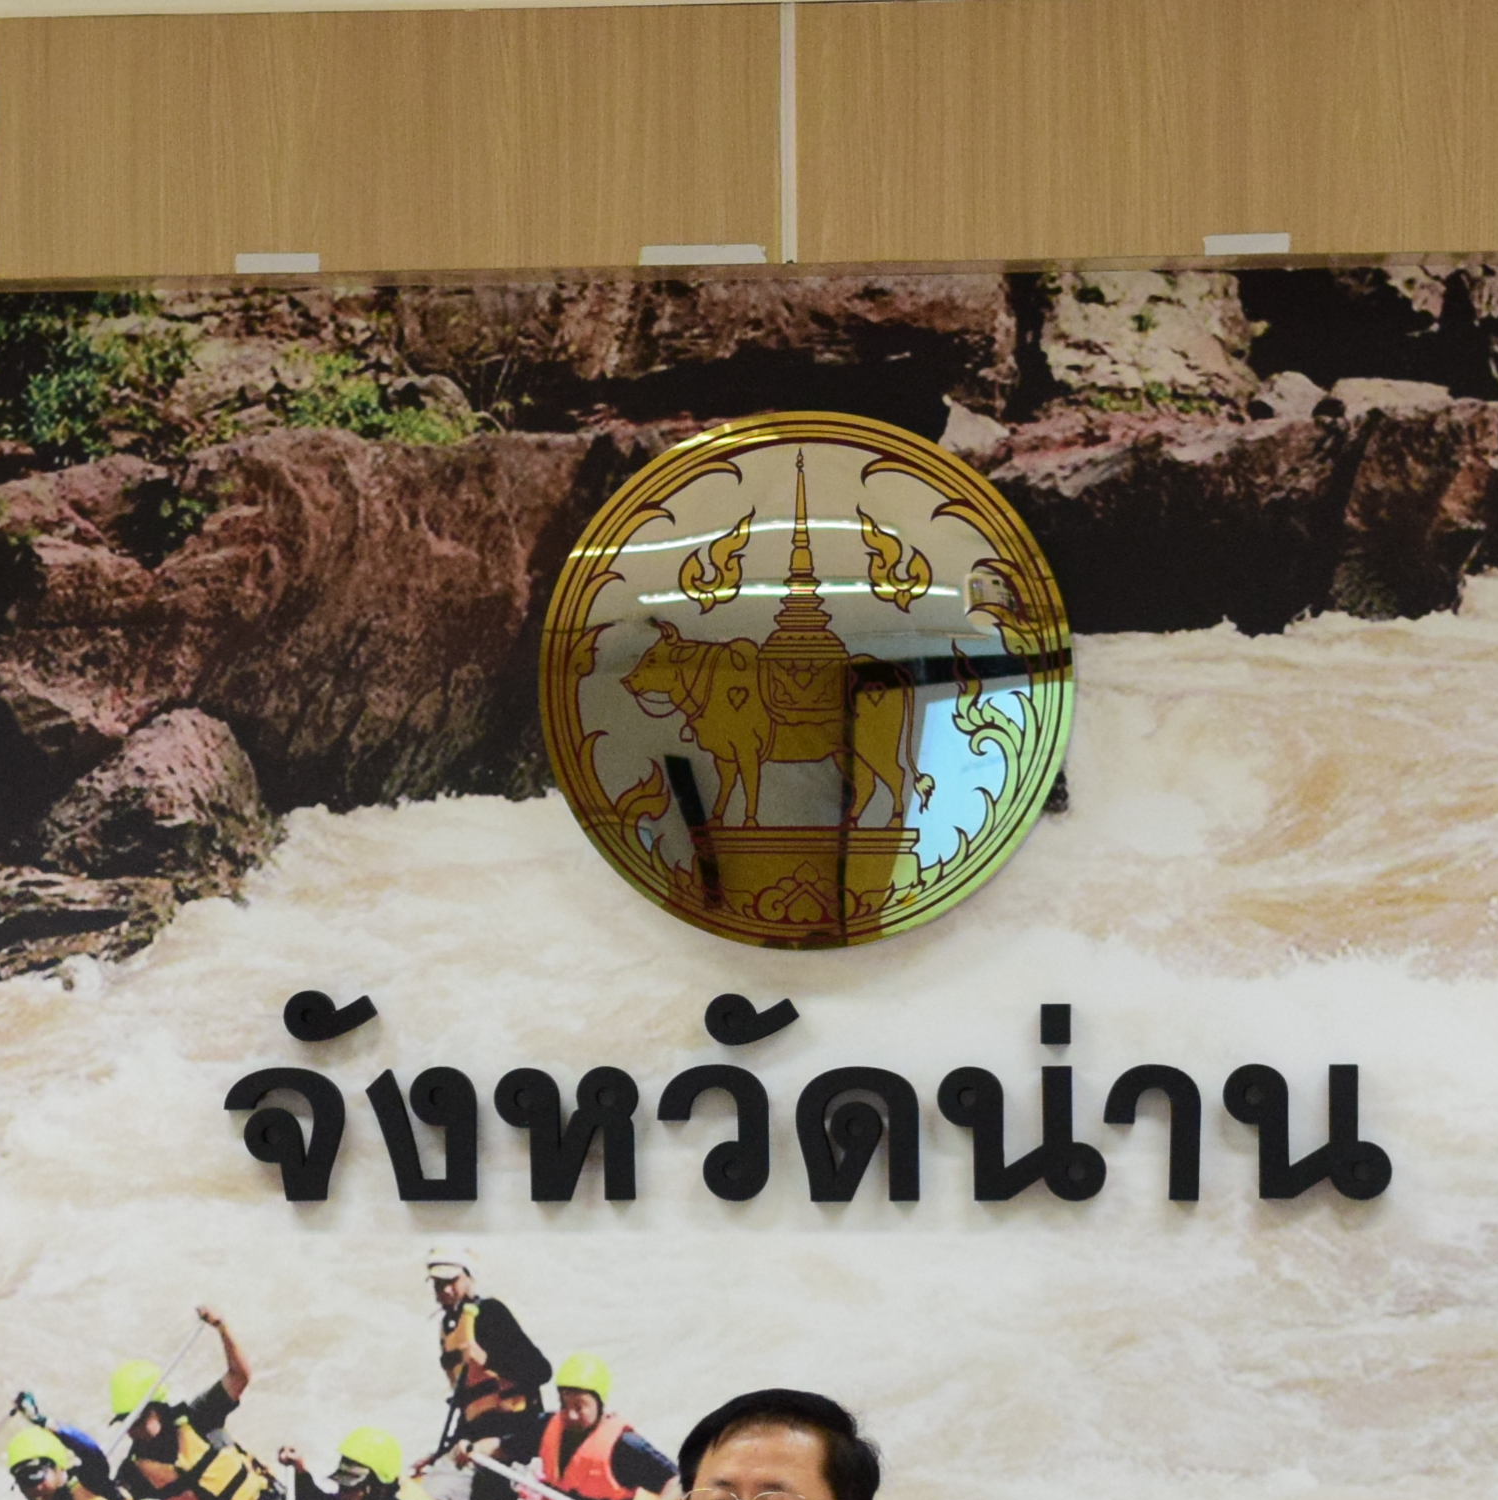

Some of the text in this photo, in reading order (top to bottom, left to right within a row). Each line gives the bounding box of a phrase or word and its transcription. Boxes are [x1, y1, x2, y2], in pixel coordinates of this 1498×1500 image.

[224, 990, 1393, 1203] จังหวัดน่าน
